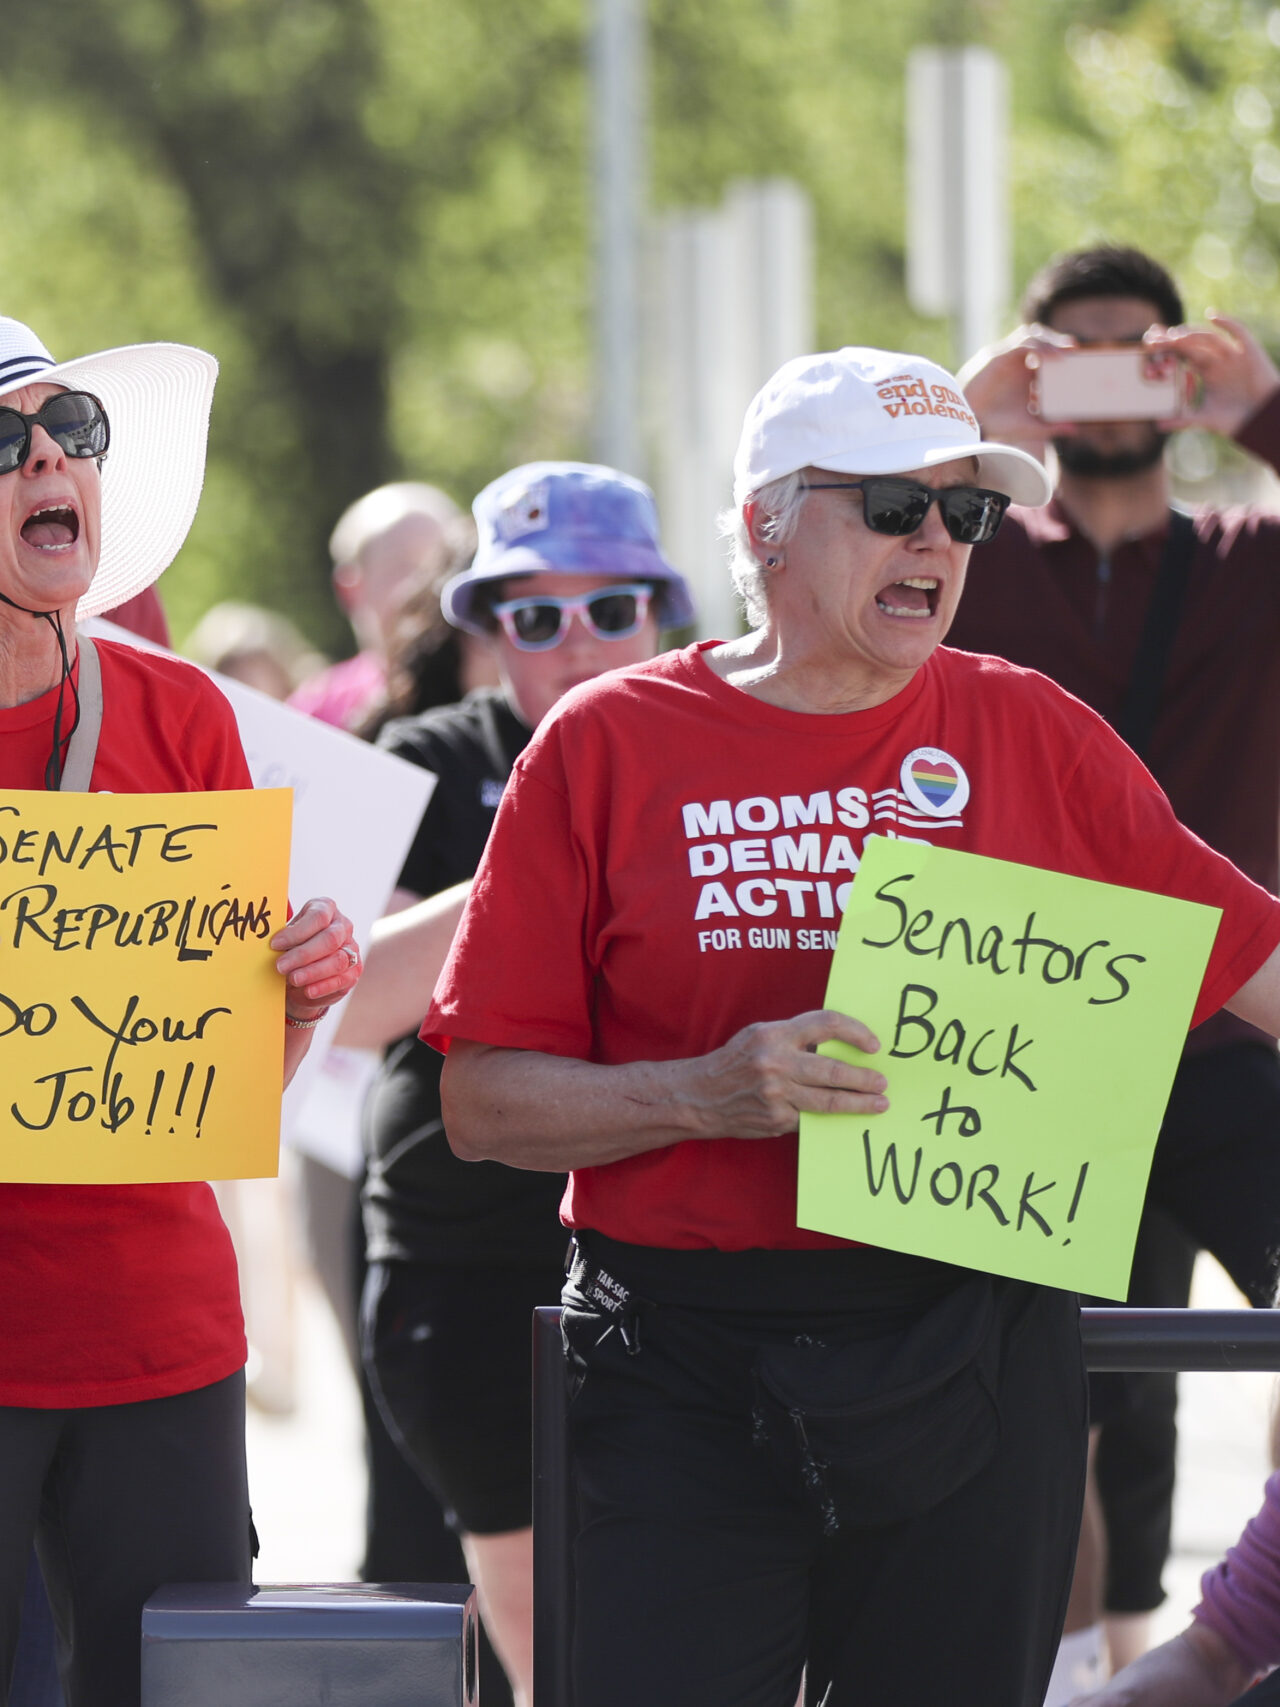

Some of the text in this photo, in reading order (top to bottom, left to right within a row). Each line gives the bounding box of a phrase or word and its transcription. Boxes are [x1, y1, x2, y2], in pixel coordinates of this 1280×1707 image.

[877, 378, 930, 399] end
[682, 787, 869, 838] MOMS
[688, 830, 933, 878] DEMA
[0, 884, 271, 962] REPUBLICANS
[694, 878, 856, 920] ACTI
[698, 927, 840, 952] FOR GUN SEN
[862, 874, 1146, 1005] Senators
[70, 995, 232, 1105] Your
[889, 984, 1038, 1092] Back
[11, 1061, 216, 1138] Job!!!
[921, 1087, 982, 1137] to
[863, 1129, 1090, 1247] WORK!
[592, 1287, 621, 1312] SPORT
[596, 1269, 630, 1302] TAN-SAC
